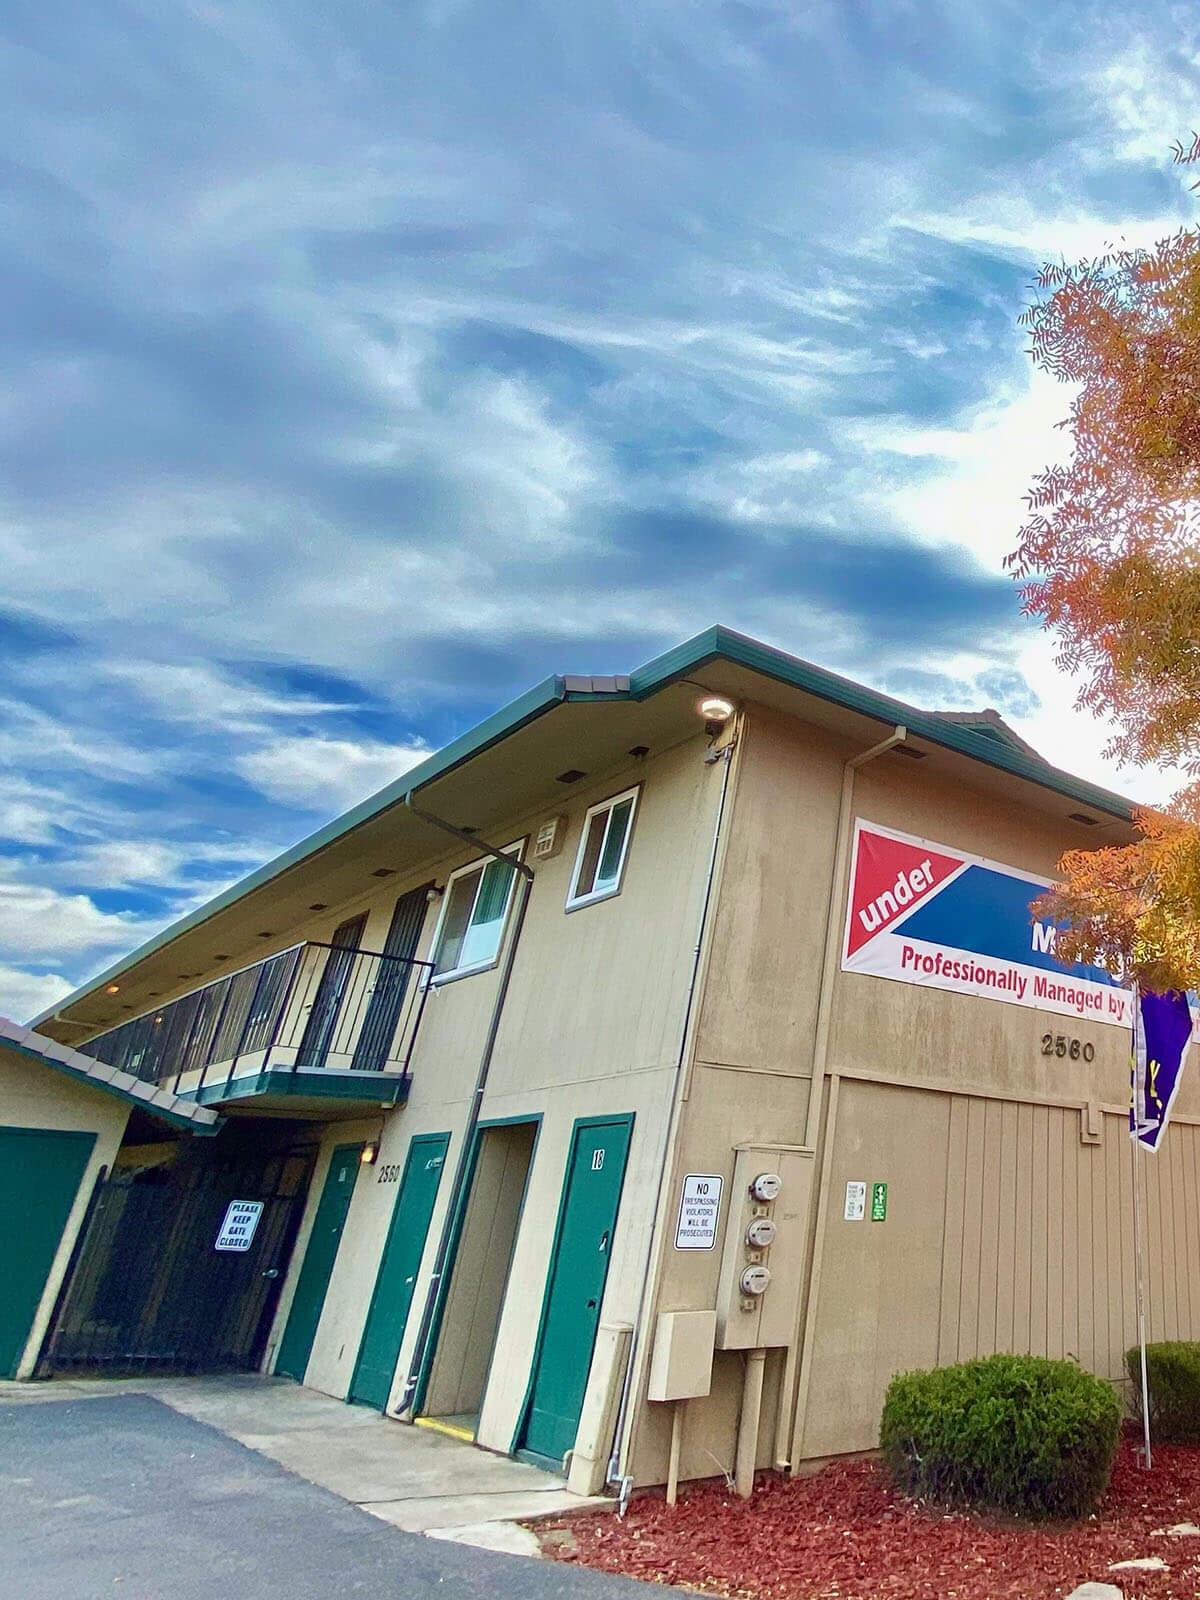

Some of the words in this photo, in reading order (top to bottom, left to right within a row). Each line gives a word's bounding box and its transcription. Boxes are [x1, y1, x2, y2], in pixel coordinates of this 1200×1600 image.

[858, 858, 935, 932] under
[901, 945, 1028, 999] Professionally
[1033, 975, 1103, 1013] Managed
[1108, 993, 1125, 1021] by
[1041, 1033, 1095, 1063] 2560
[377, 1164, 401, 1184] 2560
[696, 1183, 710, 1196] NO
[684, 1197, 719, 1206] TRESPASSING
[232, 1204, 259, 1213] PLEASE
[685, 1208, 714, 1217] VIOLATORS
[232, 1215, 252, 1224] KEEP
[687, 1219, 700, 1227] WILL
[701, 1219, 709, 1227] BE
[228, 1226, 246, 1235] GATE
[679, 1229, 713, 1238] PROSECUTED
[219, 1237, 249, 1247] CLOSED
